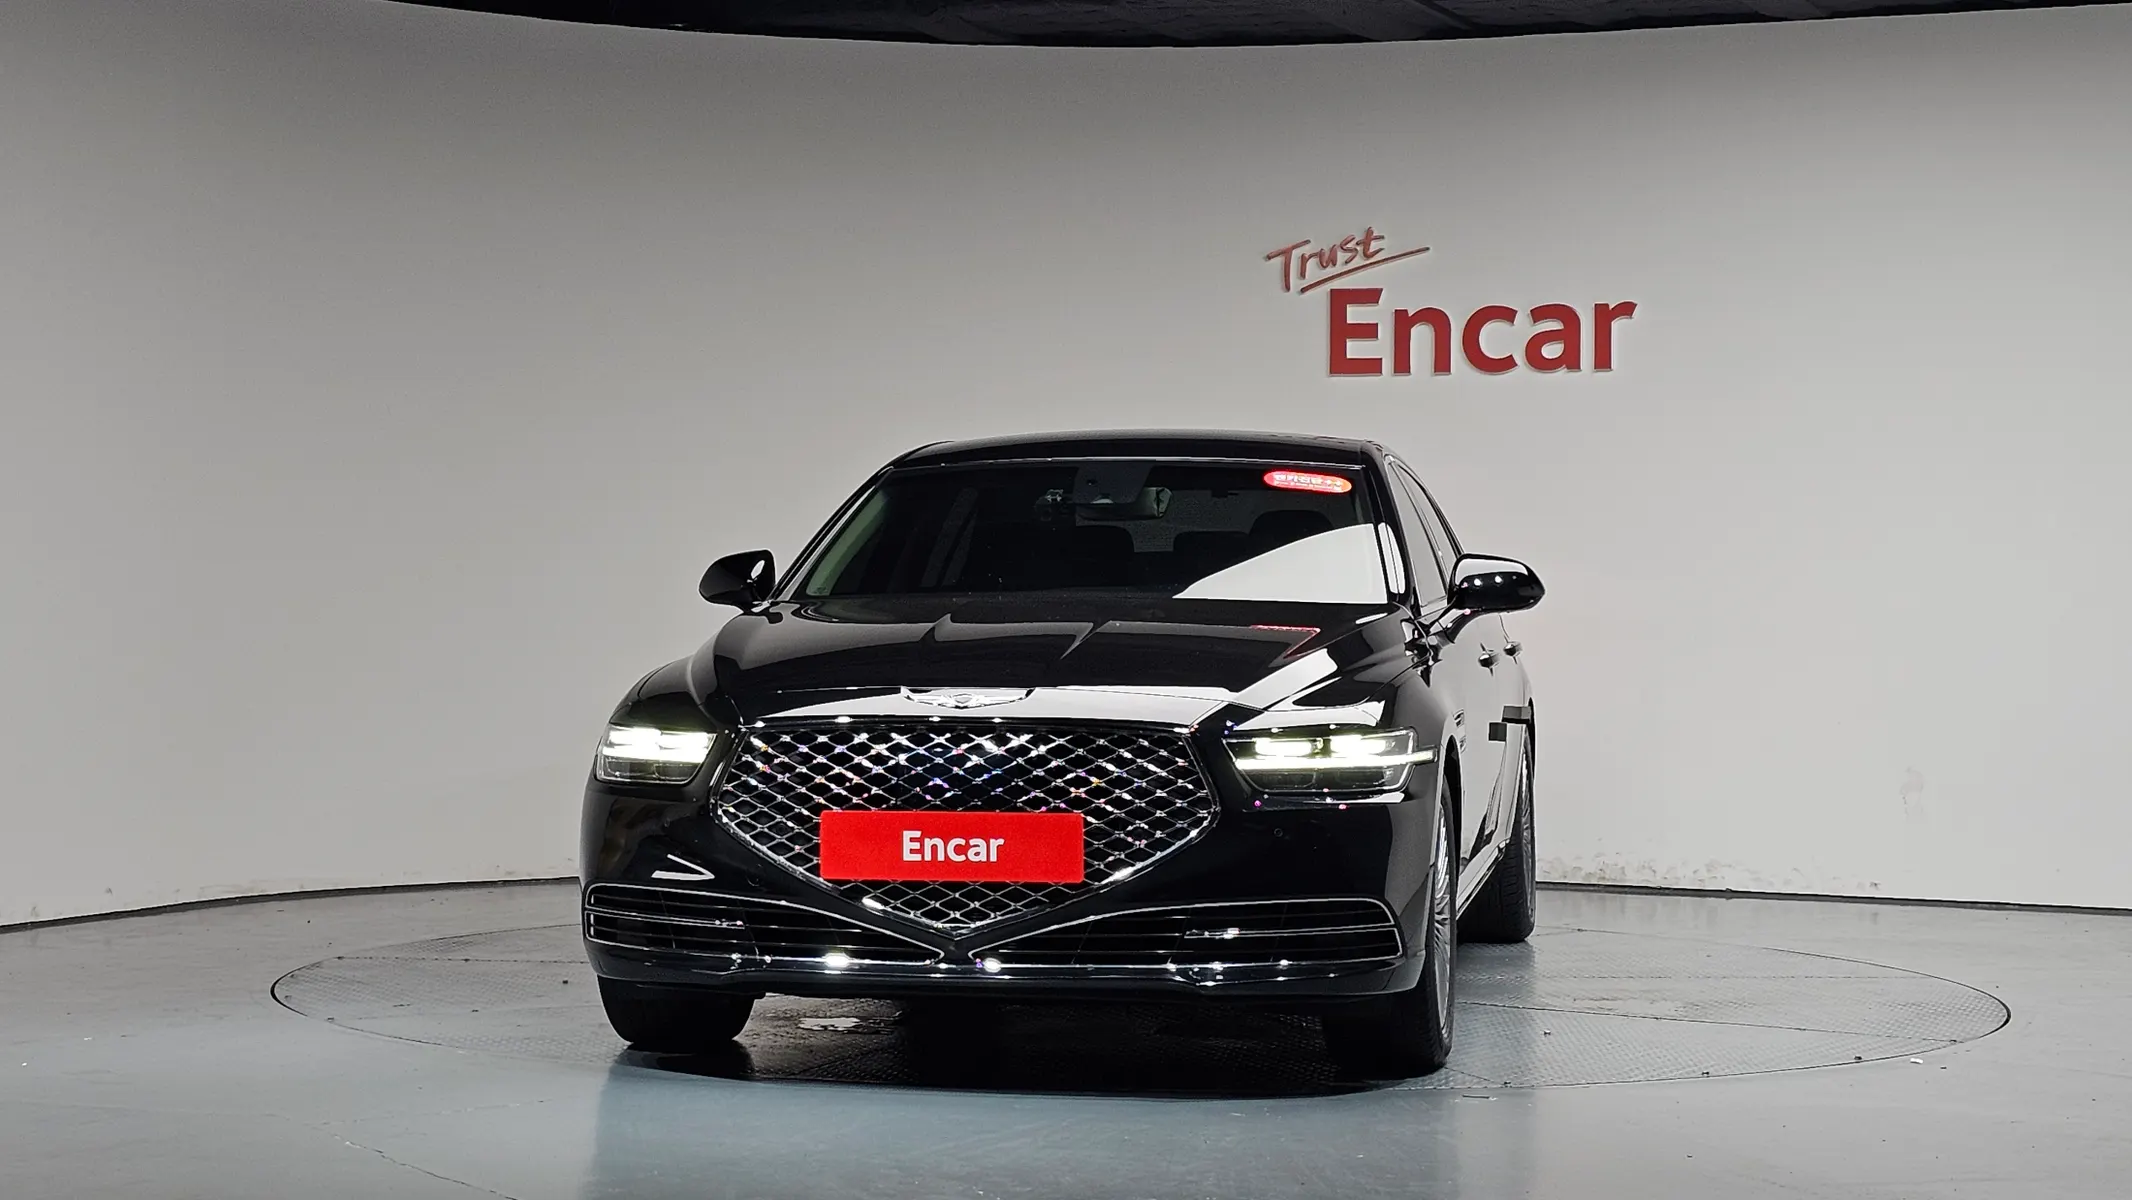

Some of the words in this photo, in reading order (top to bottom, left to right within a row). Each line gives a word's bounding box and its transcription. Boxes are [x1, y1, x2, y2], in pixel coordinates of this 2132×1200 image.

[1264, 226, 1386, 292] Trust
[1329, 287, 1638, 376] Encar
[902, 830, 1005, 862] Encar
